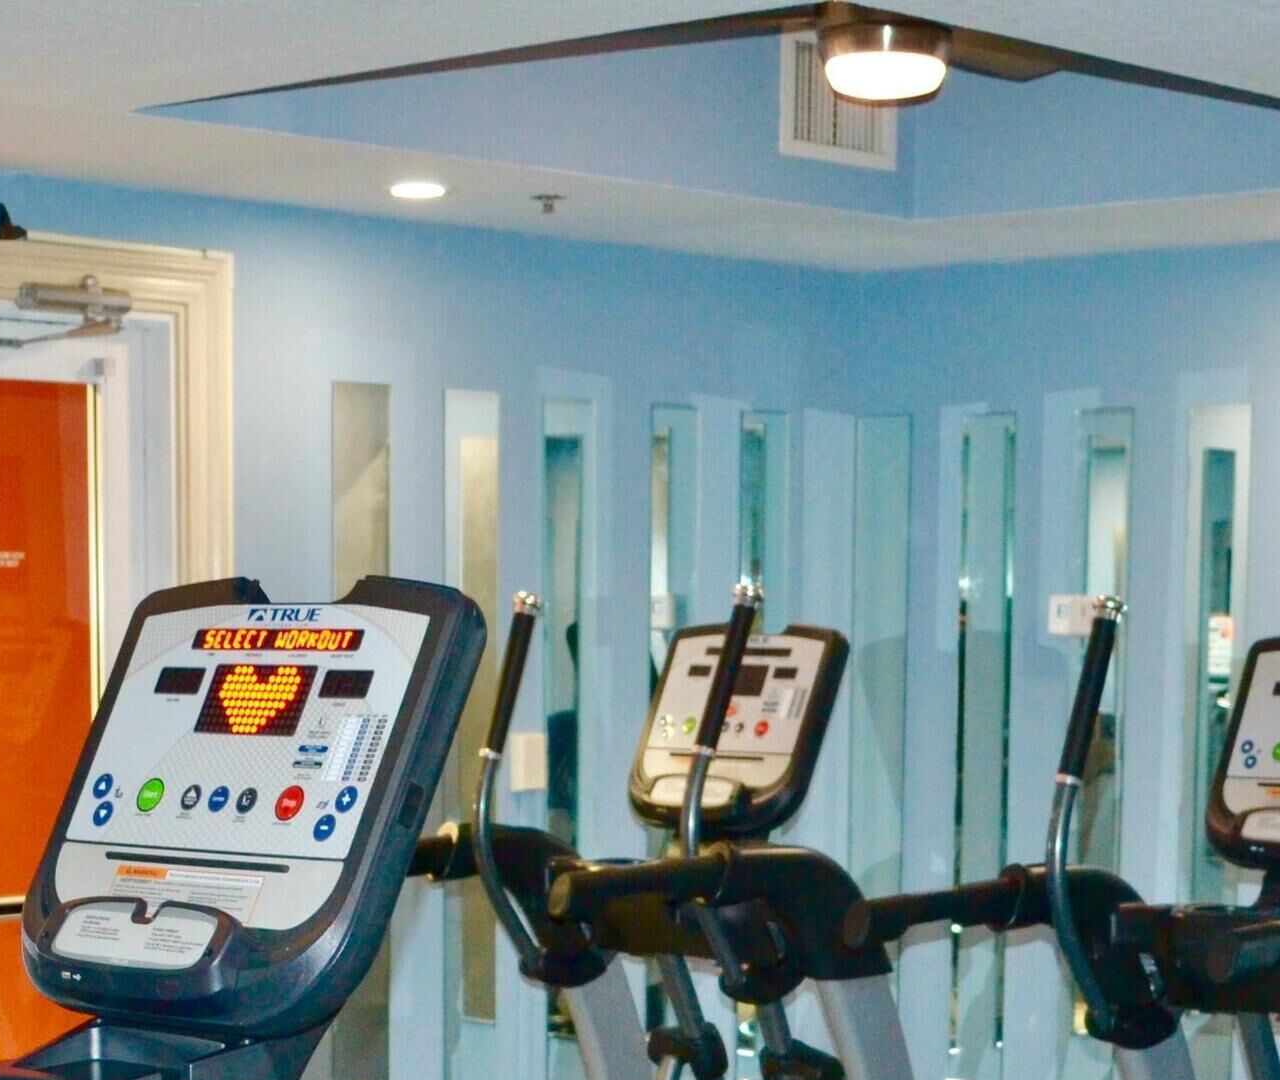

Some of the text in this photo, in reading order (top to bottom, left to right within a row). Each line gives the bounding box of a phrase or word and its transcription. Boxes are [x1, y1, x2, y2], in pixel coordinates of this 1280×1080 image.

[270, 607, 323, 622] TRUE
[202, 629, 353, 650] SELECT WORKOUT
